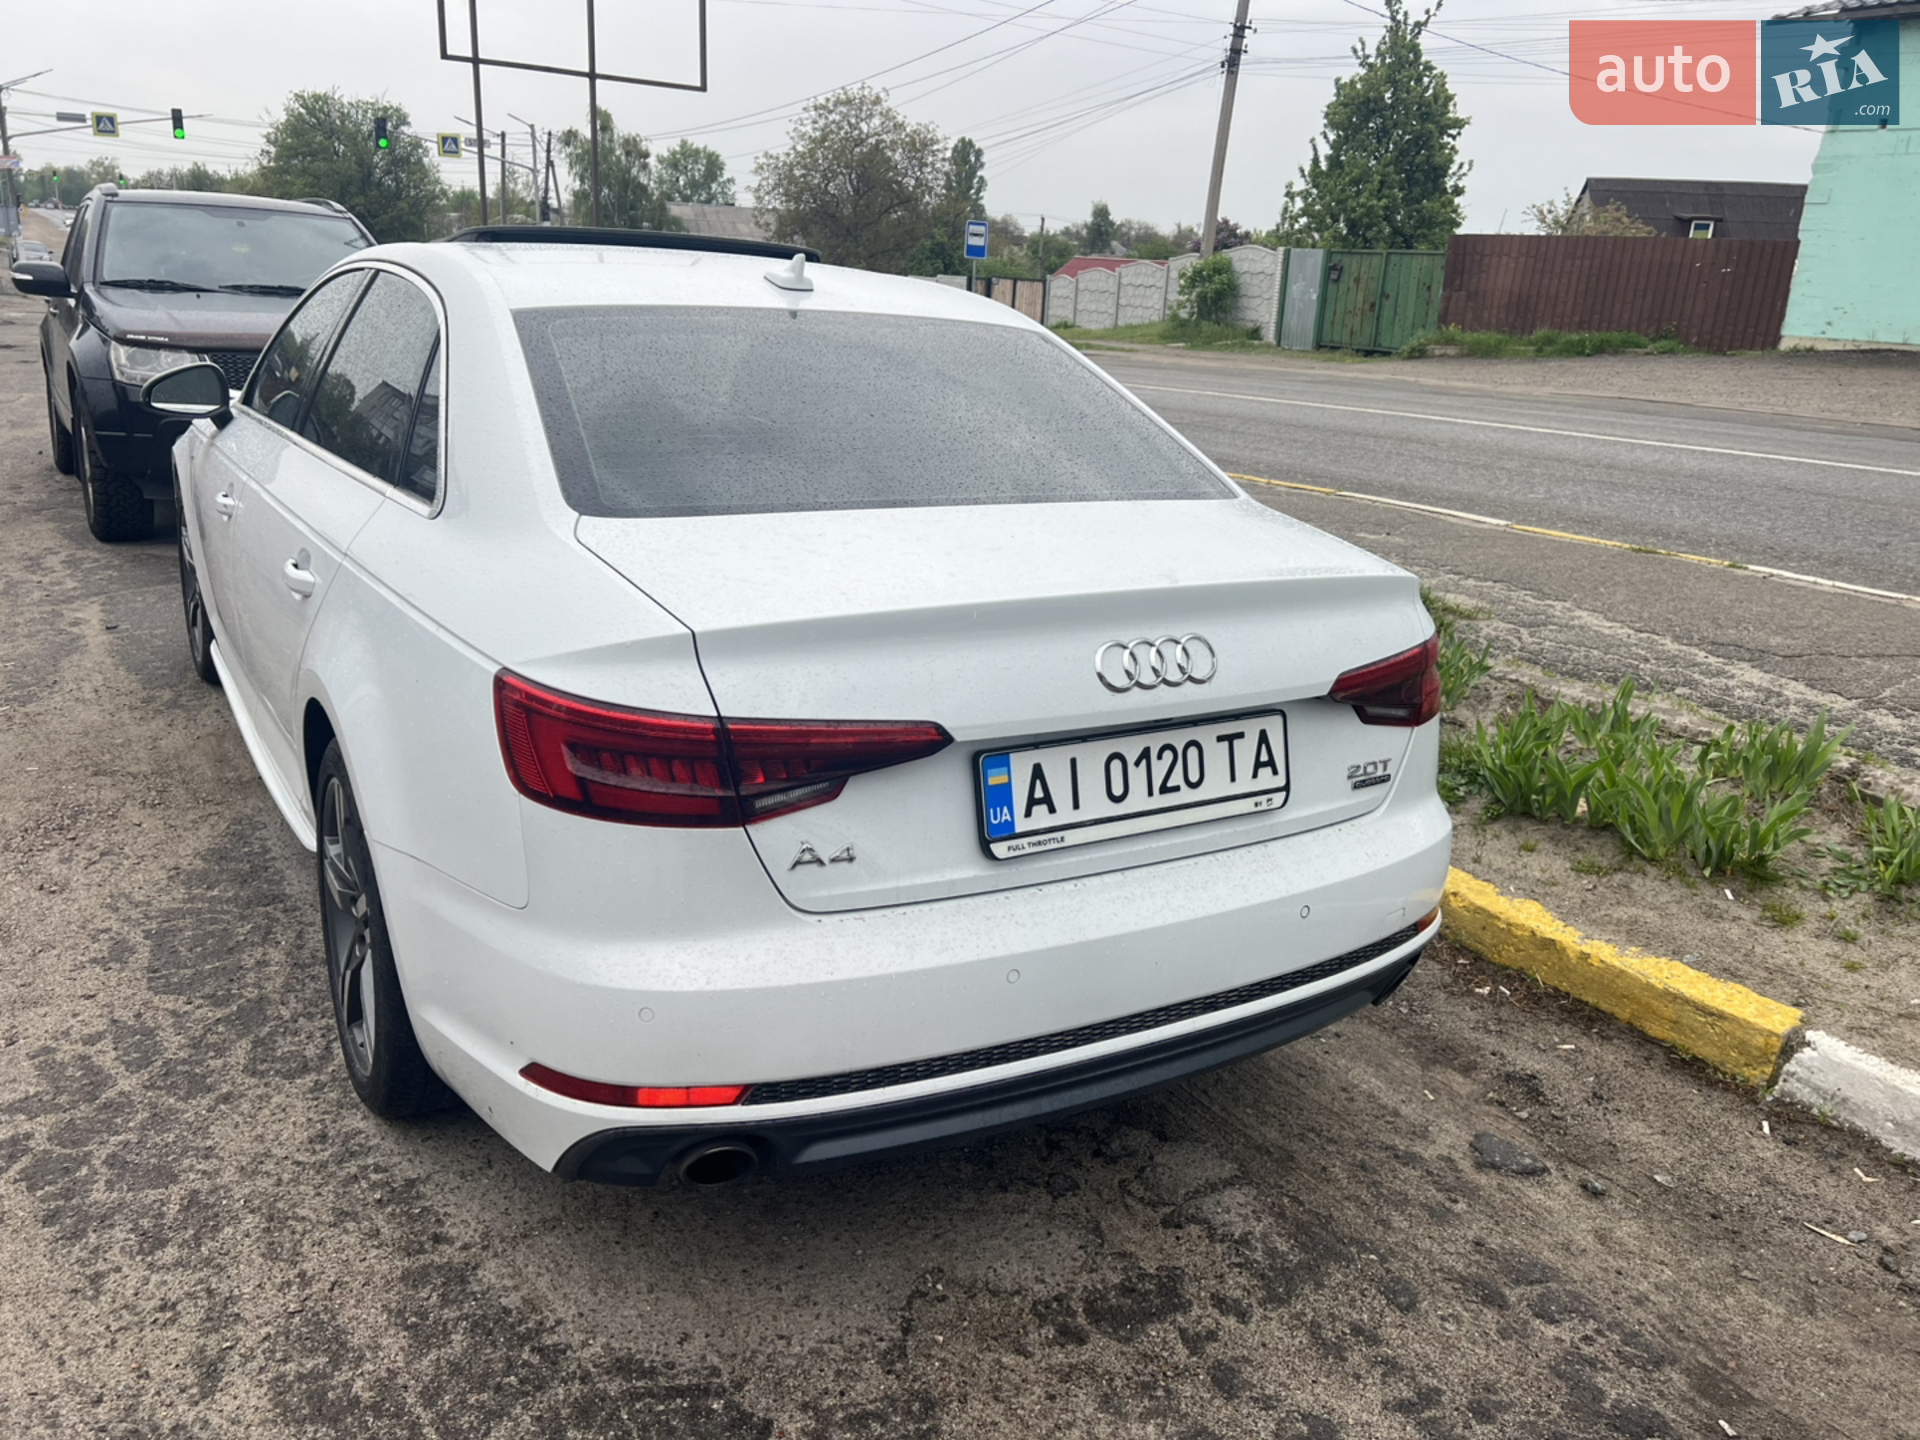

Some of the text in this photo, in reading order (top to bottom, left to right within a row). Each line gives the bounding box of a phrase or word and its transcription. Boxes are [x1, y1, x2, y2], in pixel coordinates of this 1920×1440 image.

[1023, 728, 1279, 819] AI 0120 TA
[989, 805, 1012, 825] UA
[787, 840, 857, 871] A4
[1007, 836, 1065, 852] FULL THROTTLE
